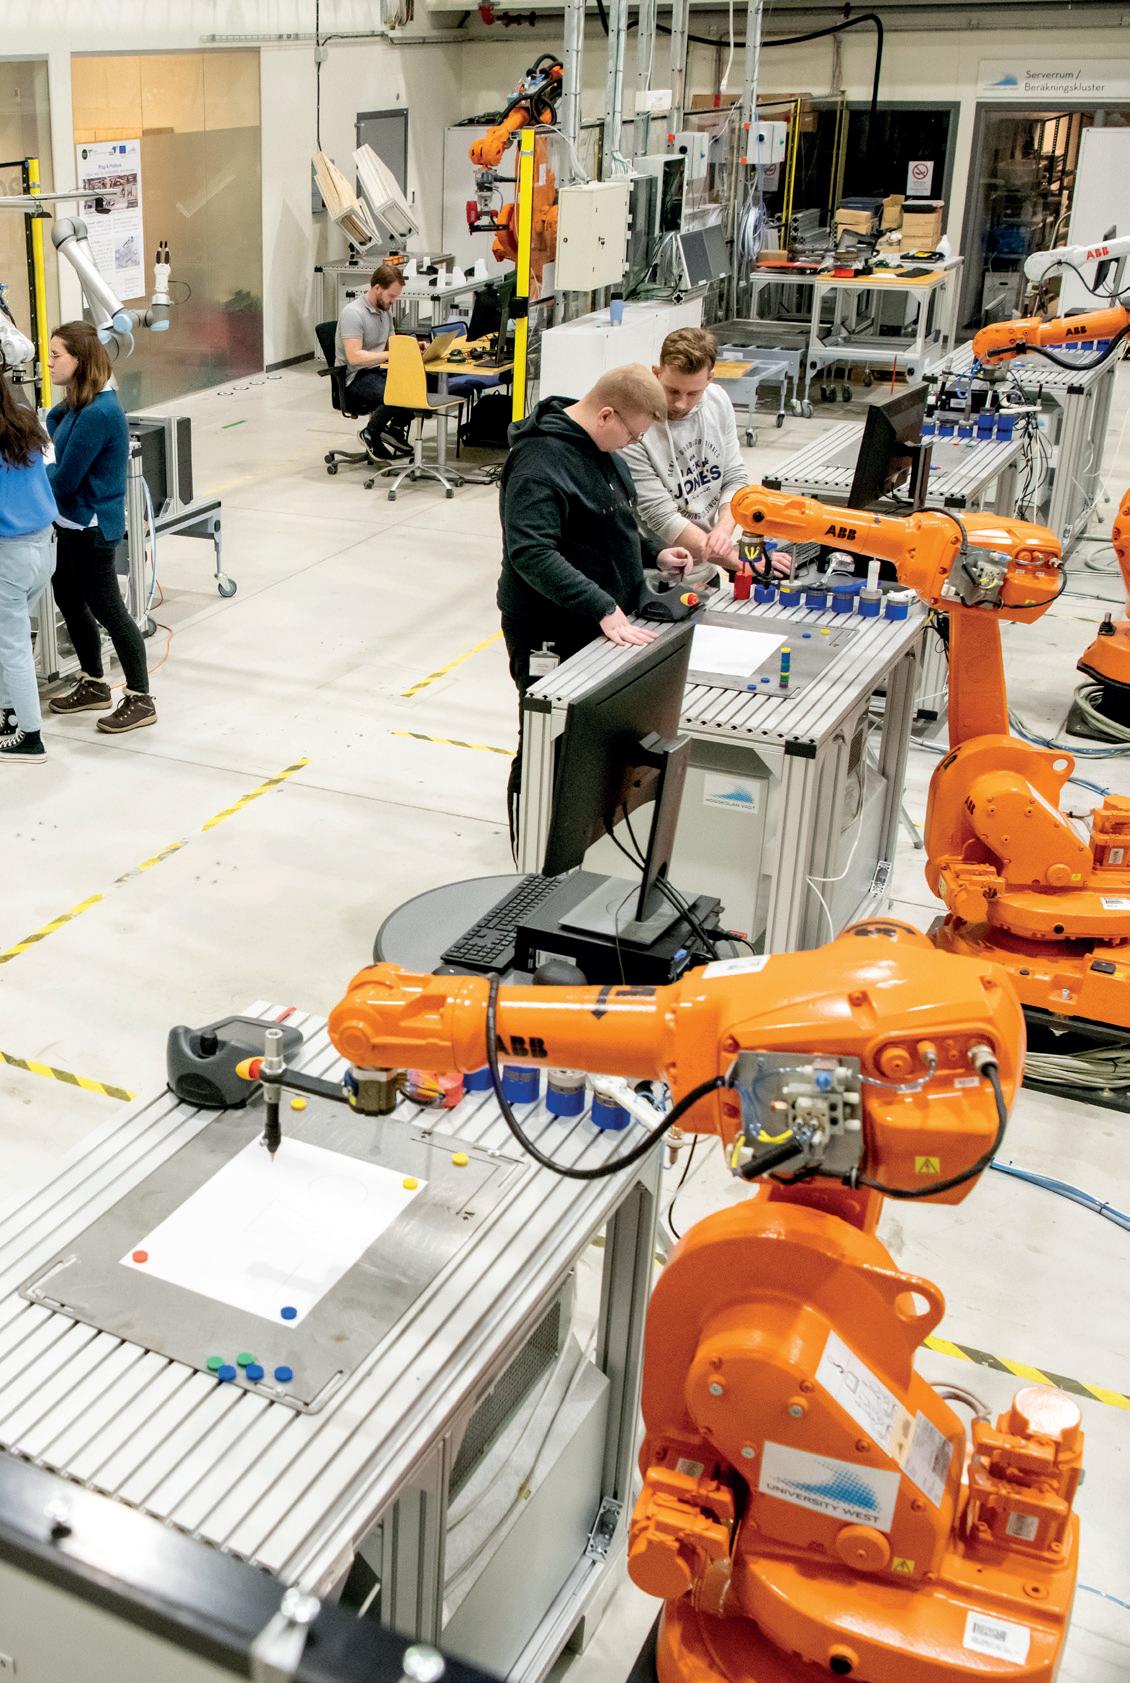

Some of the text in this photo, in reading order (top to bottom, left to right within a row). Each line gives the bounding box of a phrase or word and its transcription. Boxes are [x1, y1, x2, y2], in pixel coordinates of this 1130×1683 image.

[1025, 70, 1074, 80] Serverrum
[1086, 246, 1109, 260] ABB
[1066, 325, 1088, 337] ABB
[674, 465, 721, 499] JONES
[825, 524, 857, 541] ABB
[766, 1483, 880, 1523] UNIVERSITY WEST
